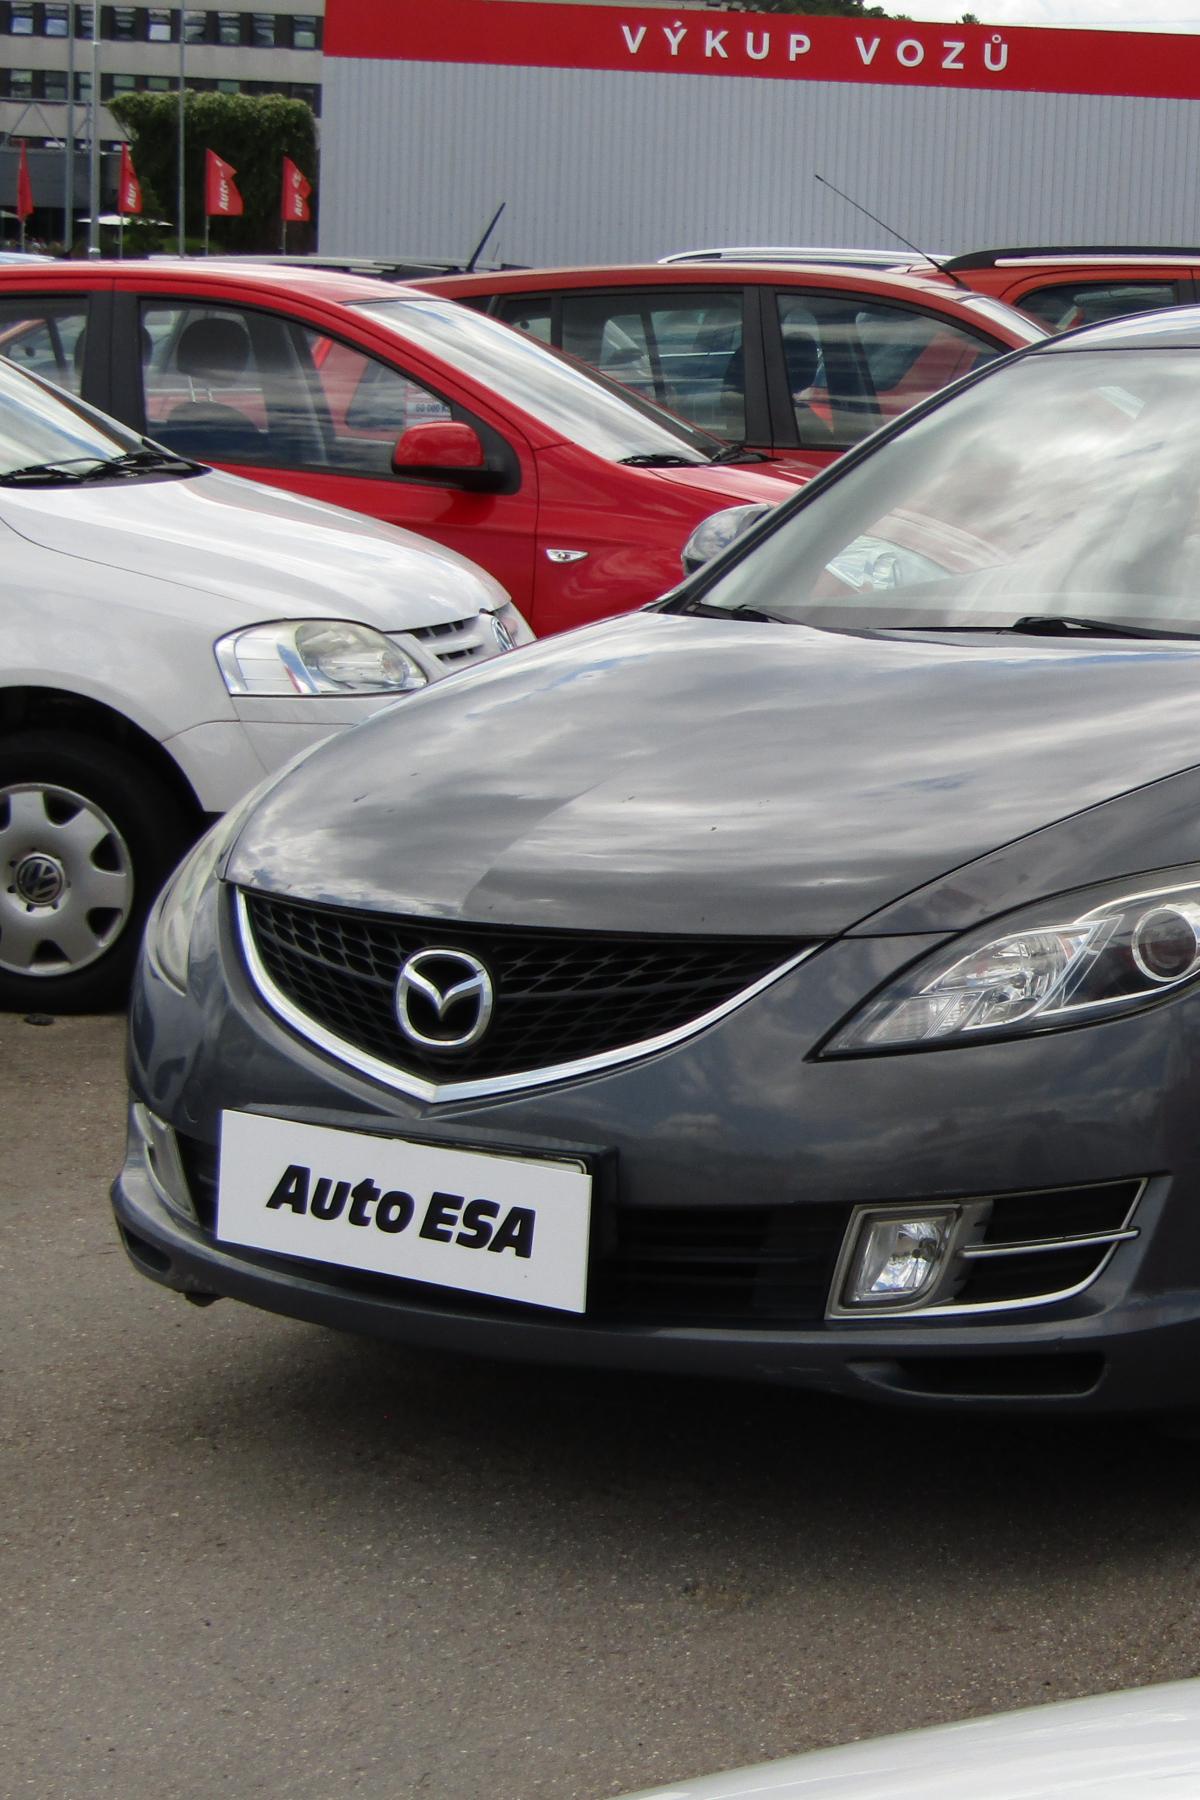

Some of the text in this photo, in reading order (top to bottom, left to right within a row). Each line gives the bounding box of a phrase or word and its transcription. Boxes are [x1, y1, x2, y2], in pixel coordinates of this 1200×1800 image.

[621, 21, 1009, 72] VÝKUP VOZŮ
[265, 1164, 537, 1259] Auto ESA
